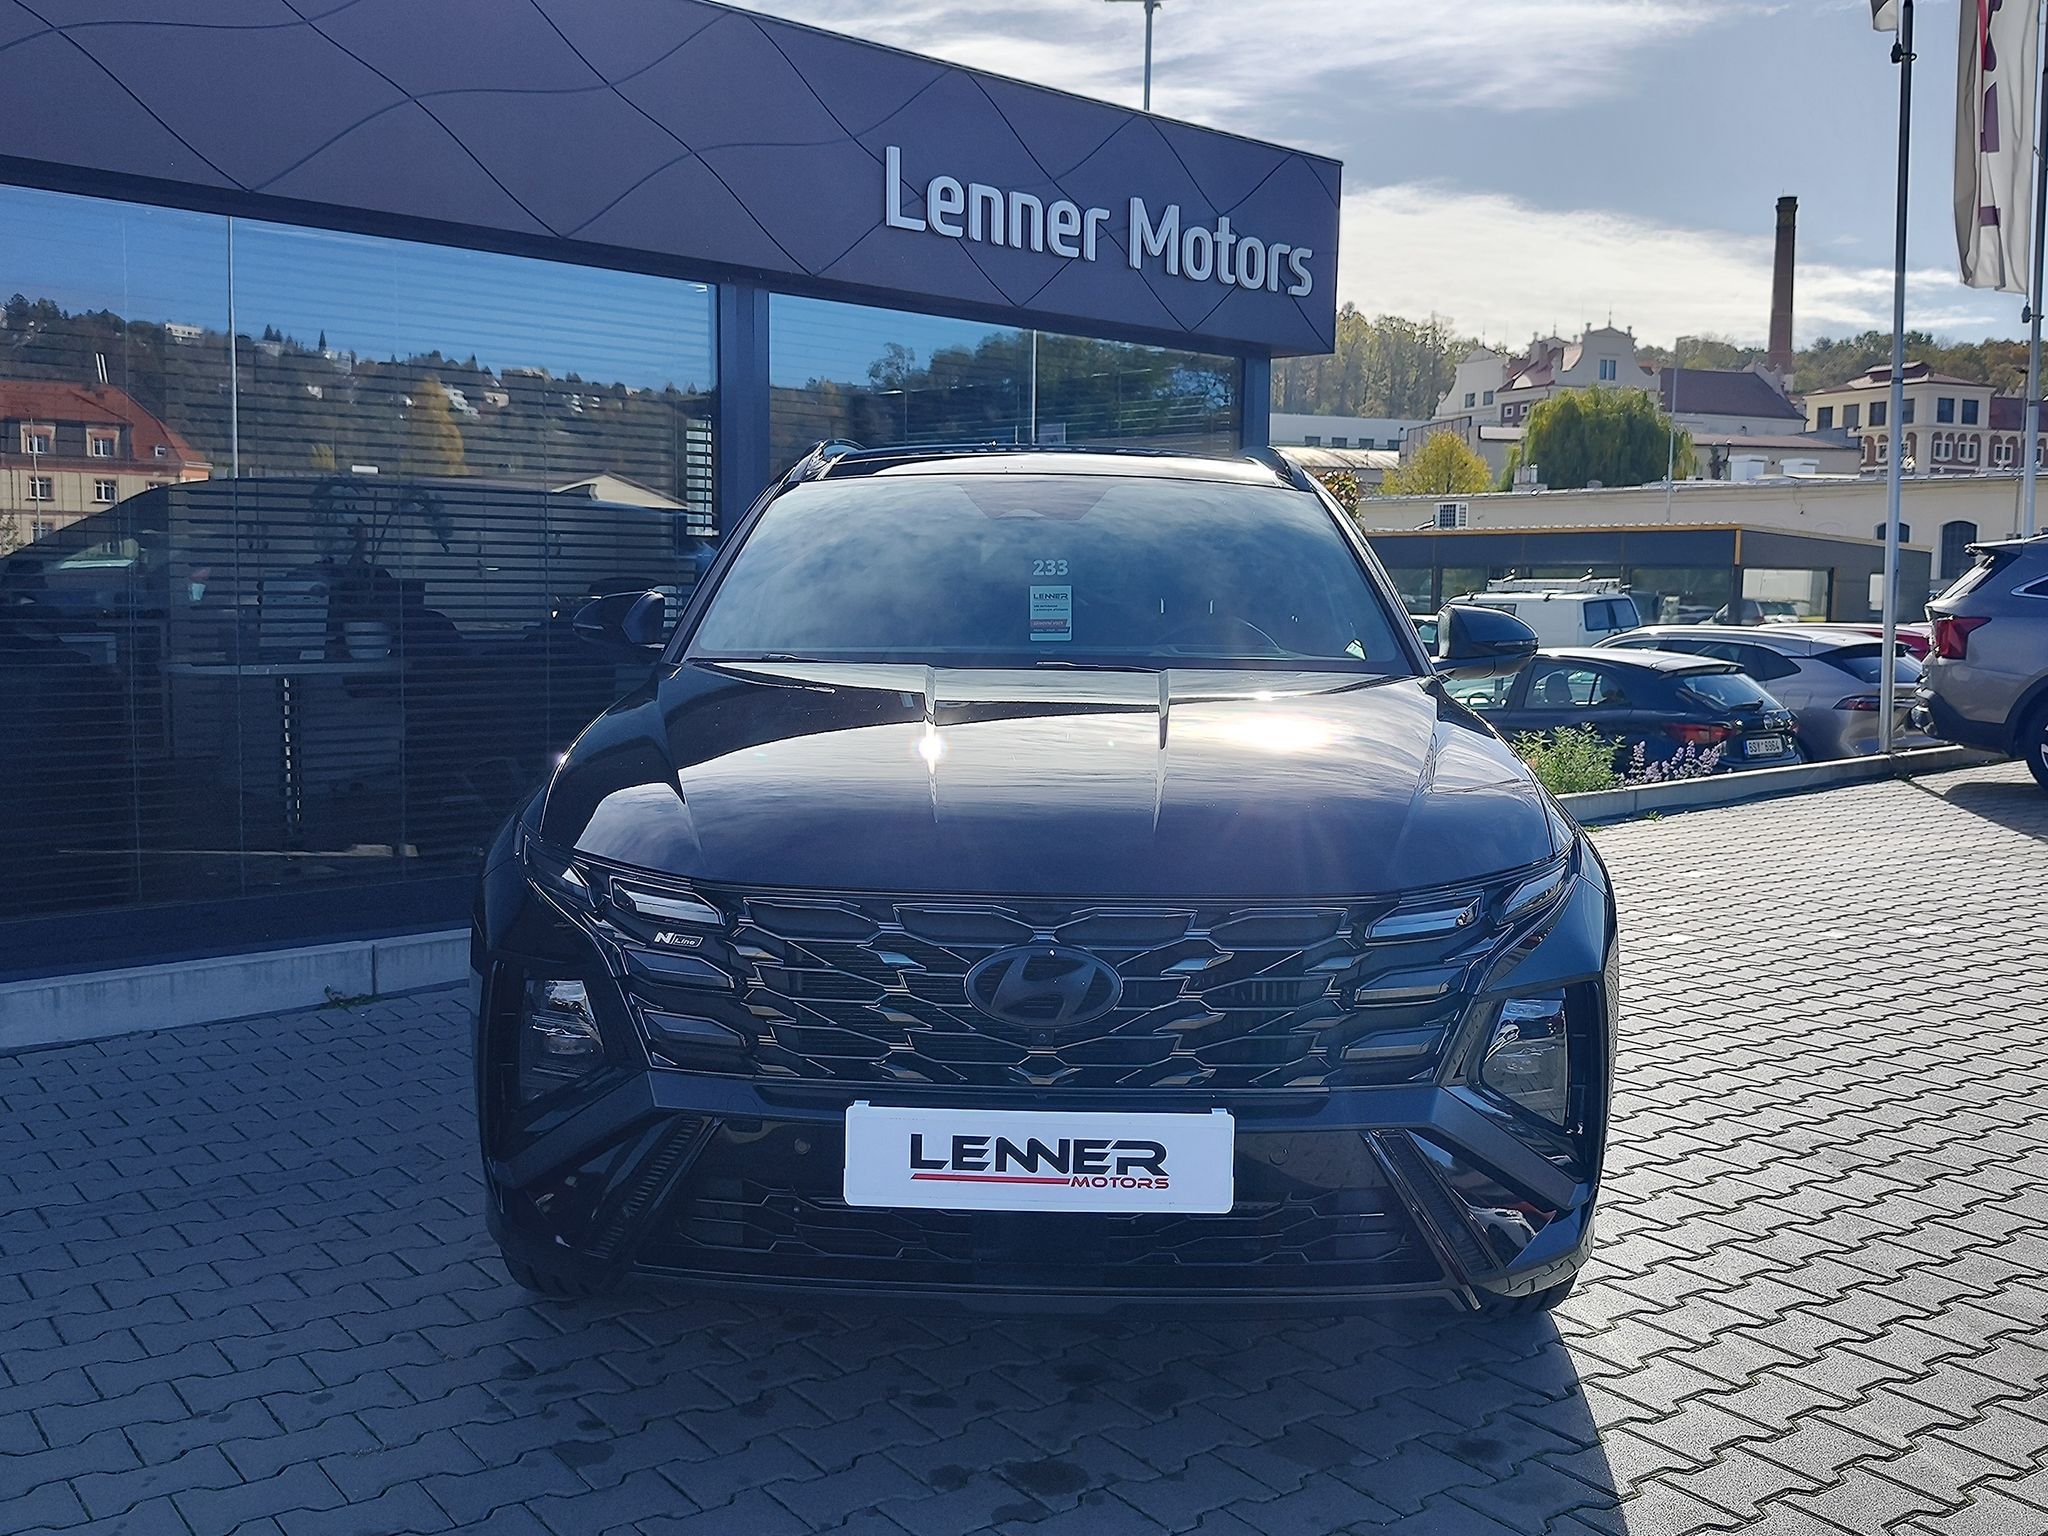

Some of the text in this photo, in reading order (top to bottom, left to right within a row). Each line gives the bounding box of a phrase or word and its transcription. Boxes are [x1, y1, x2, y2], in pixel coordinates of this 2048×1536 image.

[884, 145, 1314, 298] Lenner Motors
[1032, 559, 1069, 576] 233
[1033, 593, 1069, 601] LENNER
[654, 932, 696, 945] N Line
[909, 1132, 1171, 1177] LENNER
[1070, 1175, 1170, 1190] MOTORS
